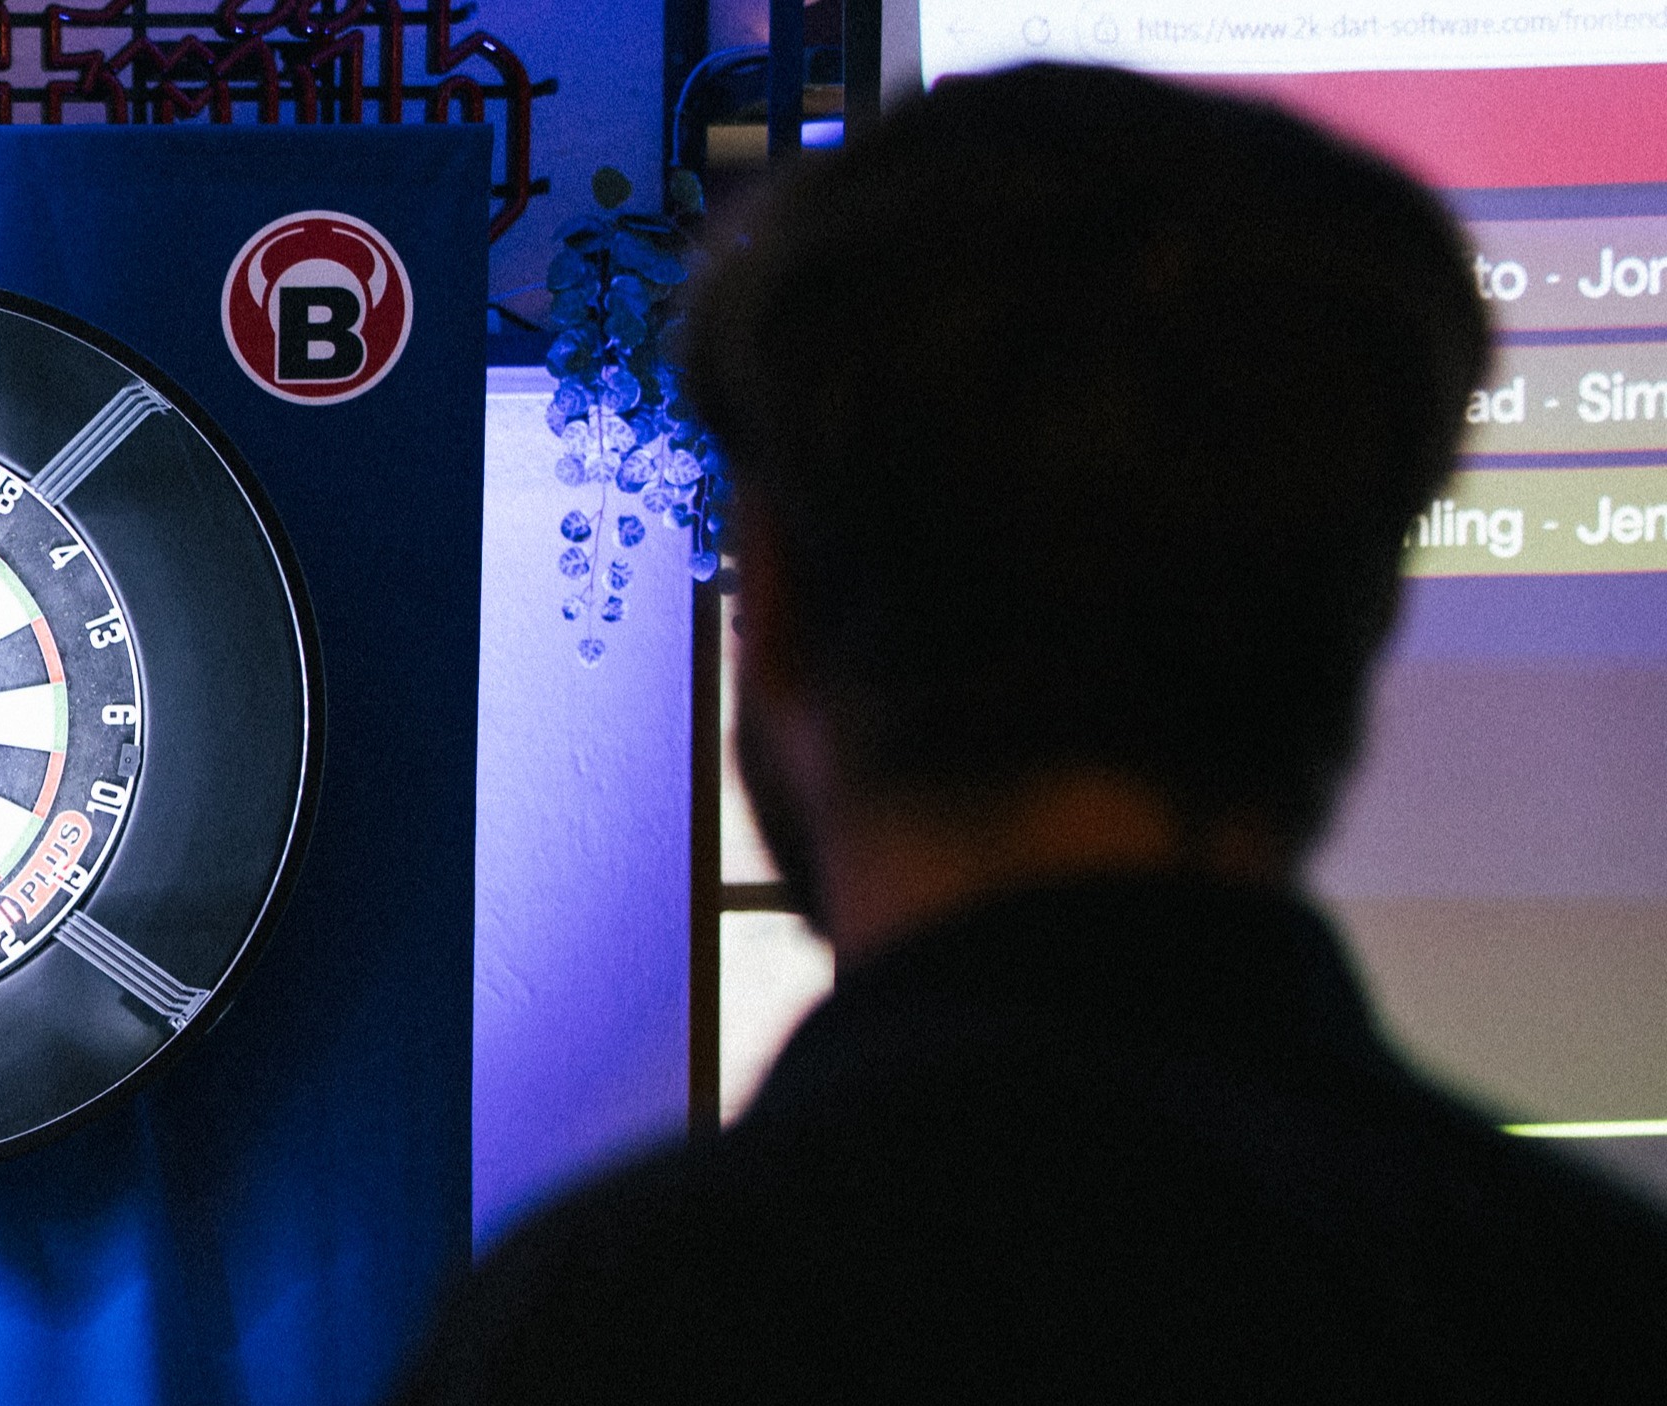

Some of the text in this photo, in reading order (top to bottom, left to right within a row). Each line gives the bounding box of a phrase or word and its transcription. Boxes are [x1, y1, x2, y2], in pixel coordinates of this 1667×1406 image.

[278, 286, 364, 380] B
[49, 543, 84, 571] 4
[85, 607, 126, 650] 13
[86, 780, 126, 819] 10
[21, 823, 81, 904] PLUS
